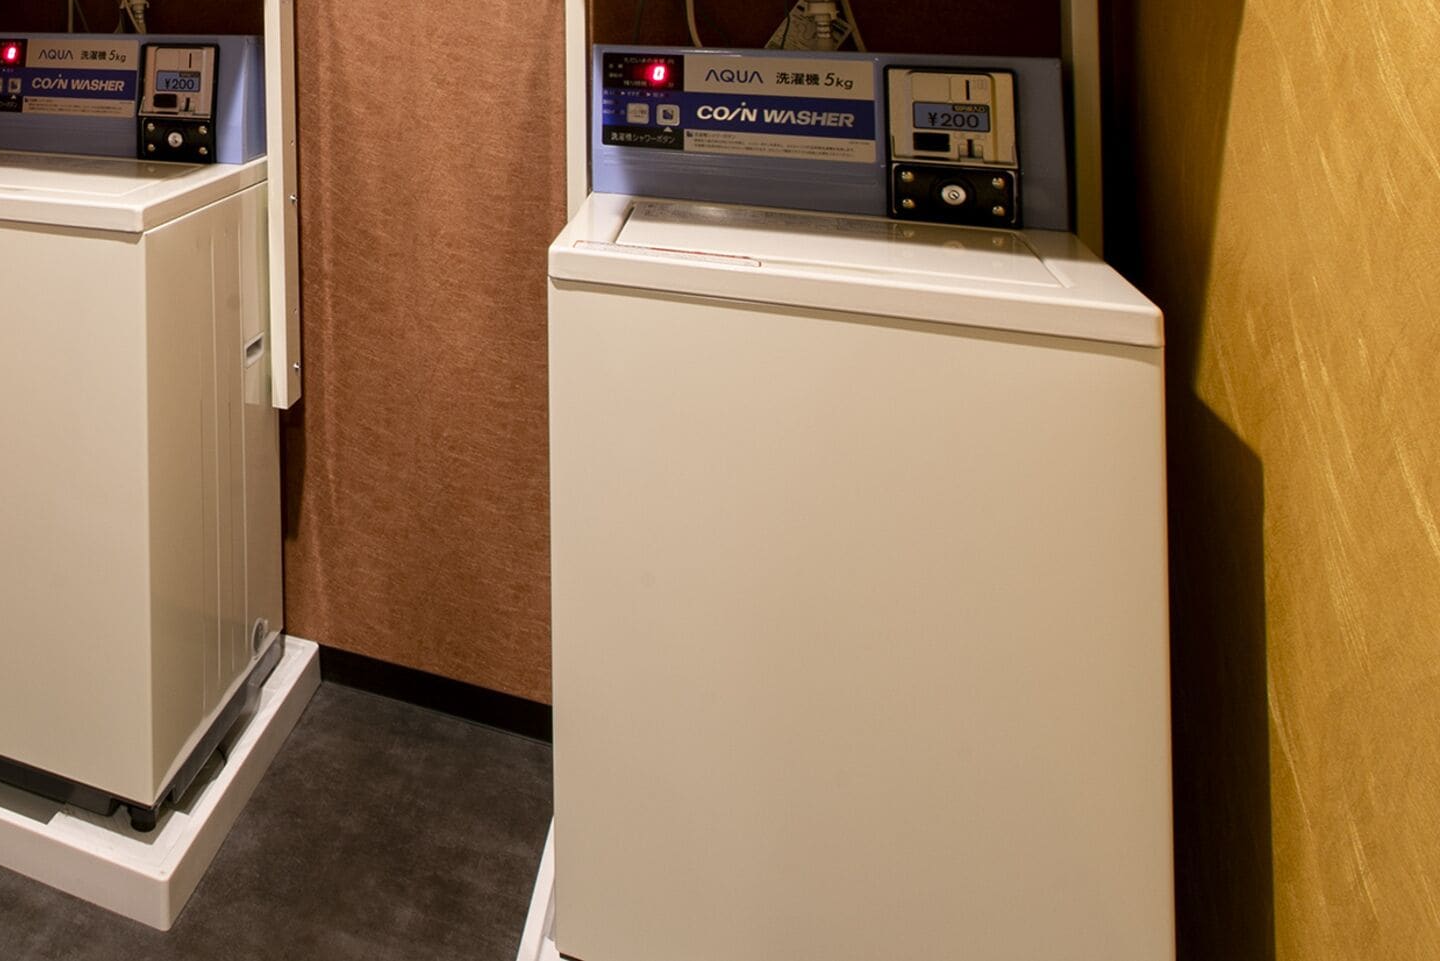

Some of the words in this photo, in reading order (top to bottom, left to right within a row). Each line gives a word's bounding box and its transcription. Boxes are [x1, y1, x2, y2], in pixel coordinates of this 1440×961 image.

[38, 49, 73, 60] AQUA
[705, 69, 764, 85] AQUA
[775, 71, 820, 86] 洗濯機
[71, 79, 125, 92] WASHER
[763, 109, 855, 128] WASHER
